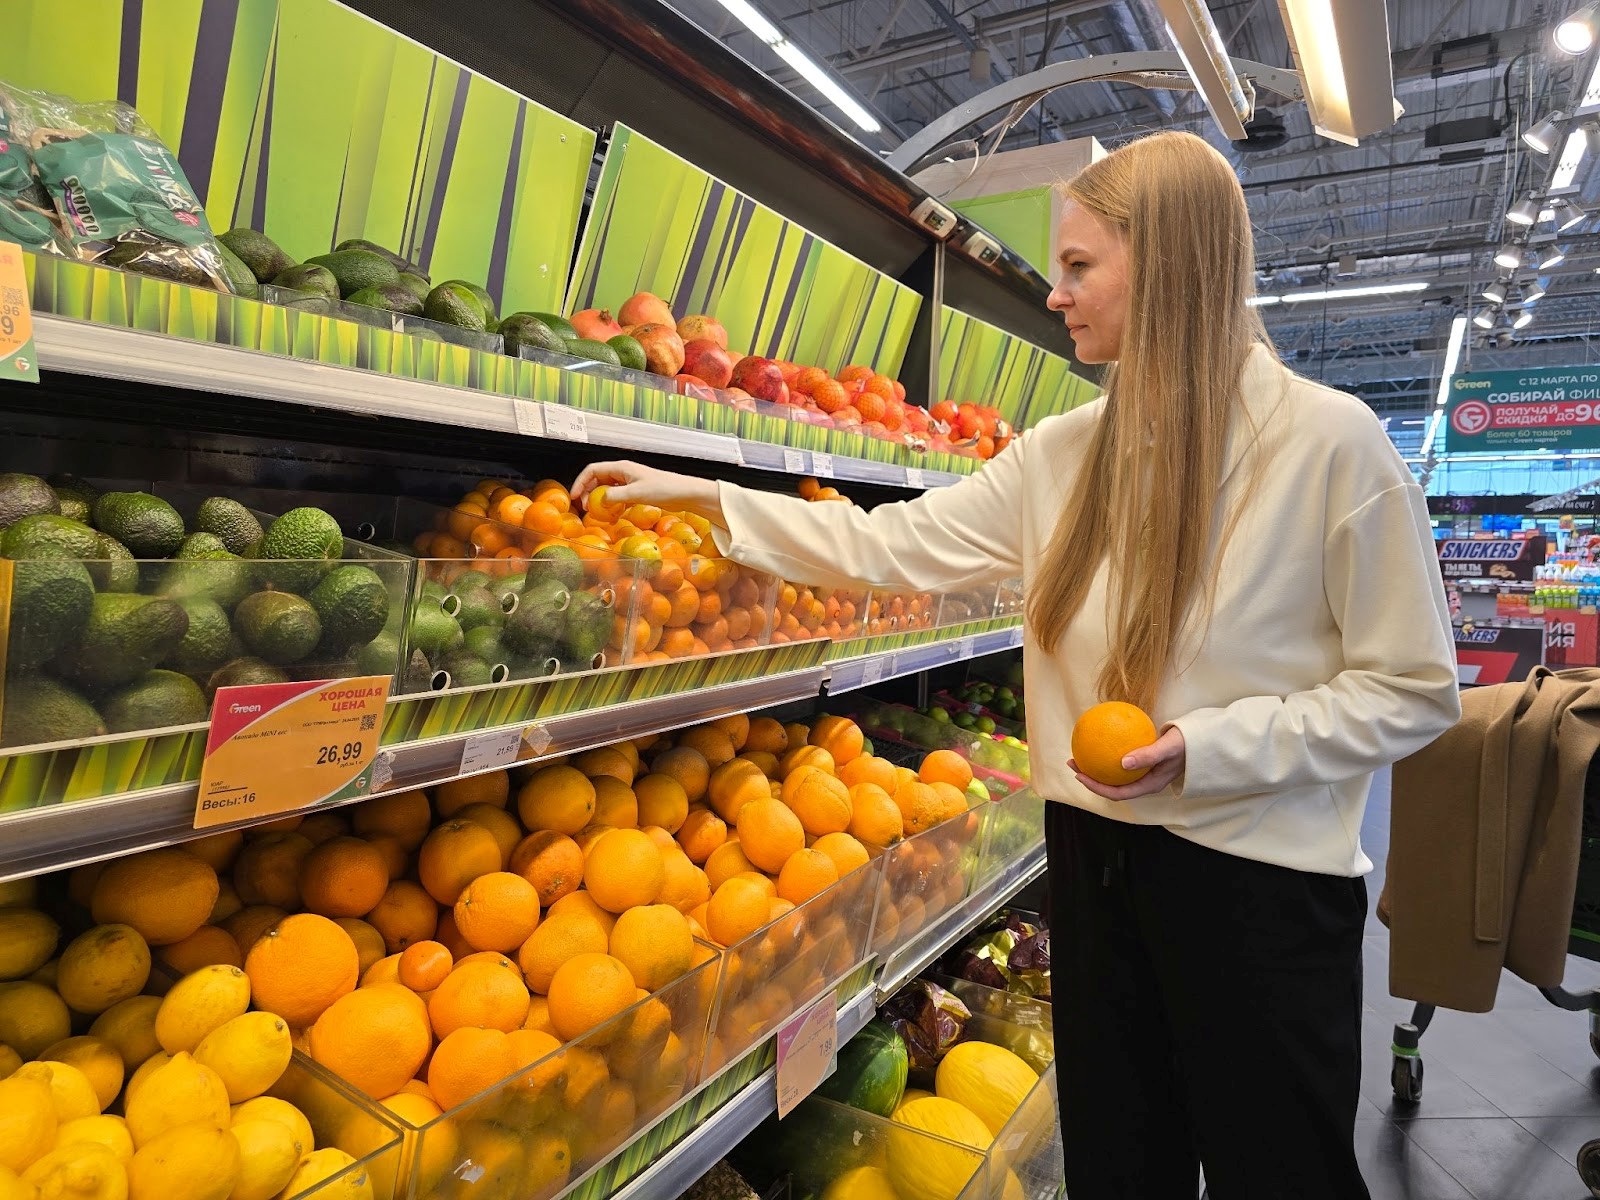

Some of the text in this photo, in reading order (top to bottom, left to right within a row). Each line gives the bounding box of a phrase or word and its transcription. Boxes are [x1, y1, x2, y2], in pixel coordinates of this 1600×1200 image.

[1454, 379, 1491, 391] Green
[1528, 377, 1539, 386] 12
[1540, 375, 1578, 385] МАРТА
[1580, 374, 1598, 384] ПО
[1487, 387, 1565, 404] СОБИРАЙ
[1496, 404, 1558, 417] ПОЛУЧАЙ
[1496, 415, 1547, 425] СКИДКИ
[1486, 429, 1573, 439] Более 60 товаров
[1441, 542, 1522, 559] SNICKERS
[318, 687, 383, 702] ХОРОШАЯ
[229, 703, 262, 714] Green
[331, 700, 366, 712] ЦЕНА
[316, 741, 362, 765] 26,99
[201, 792, 256, 811] Весы:16
